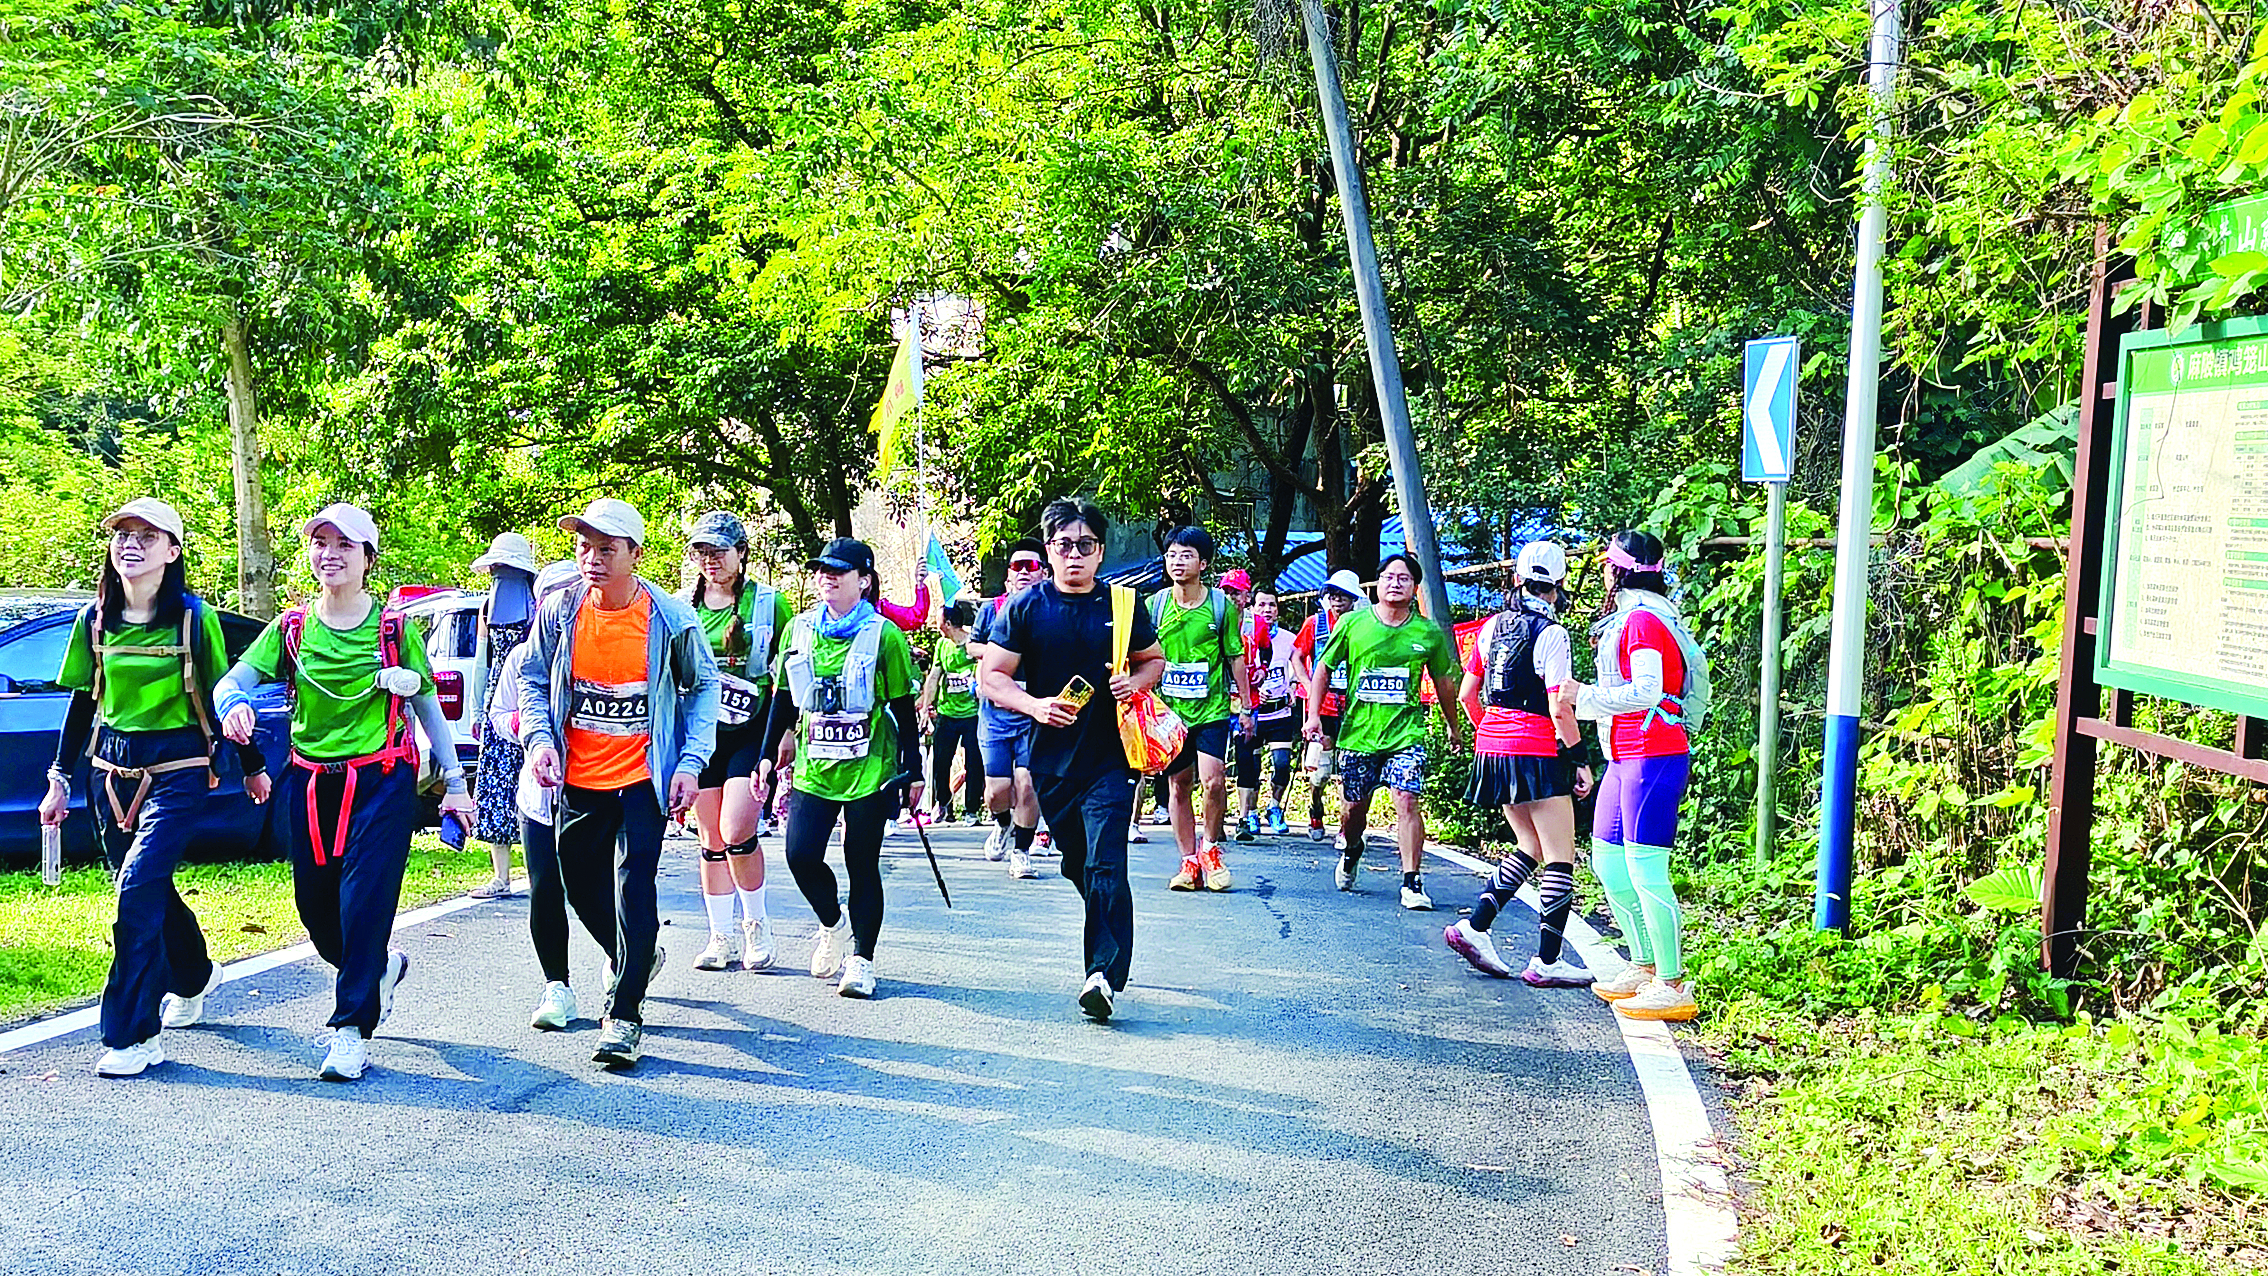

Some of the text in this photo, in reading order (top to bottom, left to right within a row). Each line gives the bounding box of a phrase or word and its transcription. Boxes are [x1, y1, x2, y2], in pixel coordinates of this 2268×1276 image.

[1165, 673, 1203, 684] A0249
[1361, 678, 1403, 690] A0250
[581, 697, 645, 716] A0226
[722, 690, 750, 709] 159
[814, 724, 864, 740] B0160
